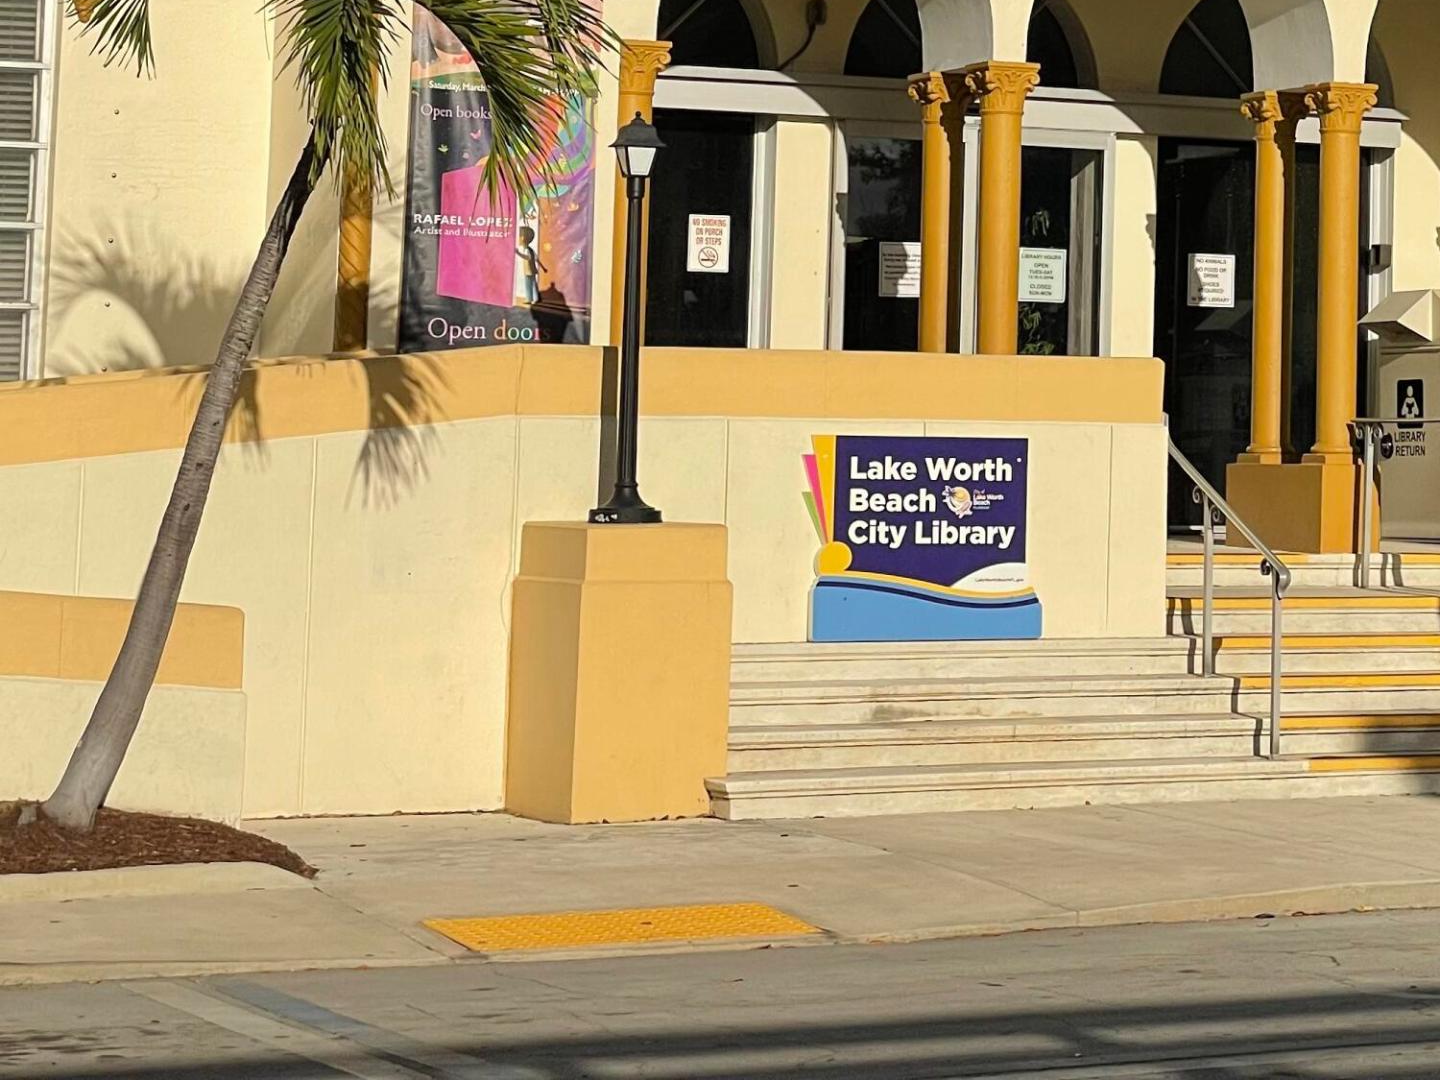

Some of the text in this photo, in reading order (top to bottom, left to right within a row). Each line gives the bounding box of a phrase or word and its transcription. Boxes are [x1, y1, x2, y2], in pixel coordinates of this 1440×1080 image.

[429, 80, 486, 93] Saturday, March
[420, 103, 493, 121] Open books
[413, 213, 465, 226] RAFAEL
[413, 226, 442, 235] Artist
[444, 228, 460, 236] and
[427, 317, 487, 346] Open
[1394, 431, 1426, 443] LIBRARY
[1396, 445, 1426, 457] RETURN
[850, 455, 1013, 482] Lake Worth
[848, 487, 937, 513] Beach
[847, 519, 1016, 550] City Library
